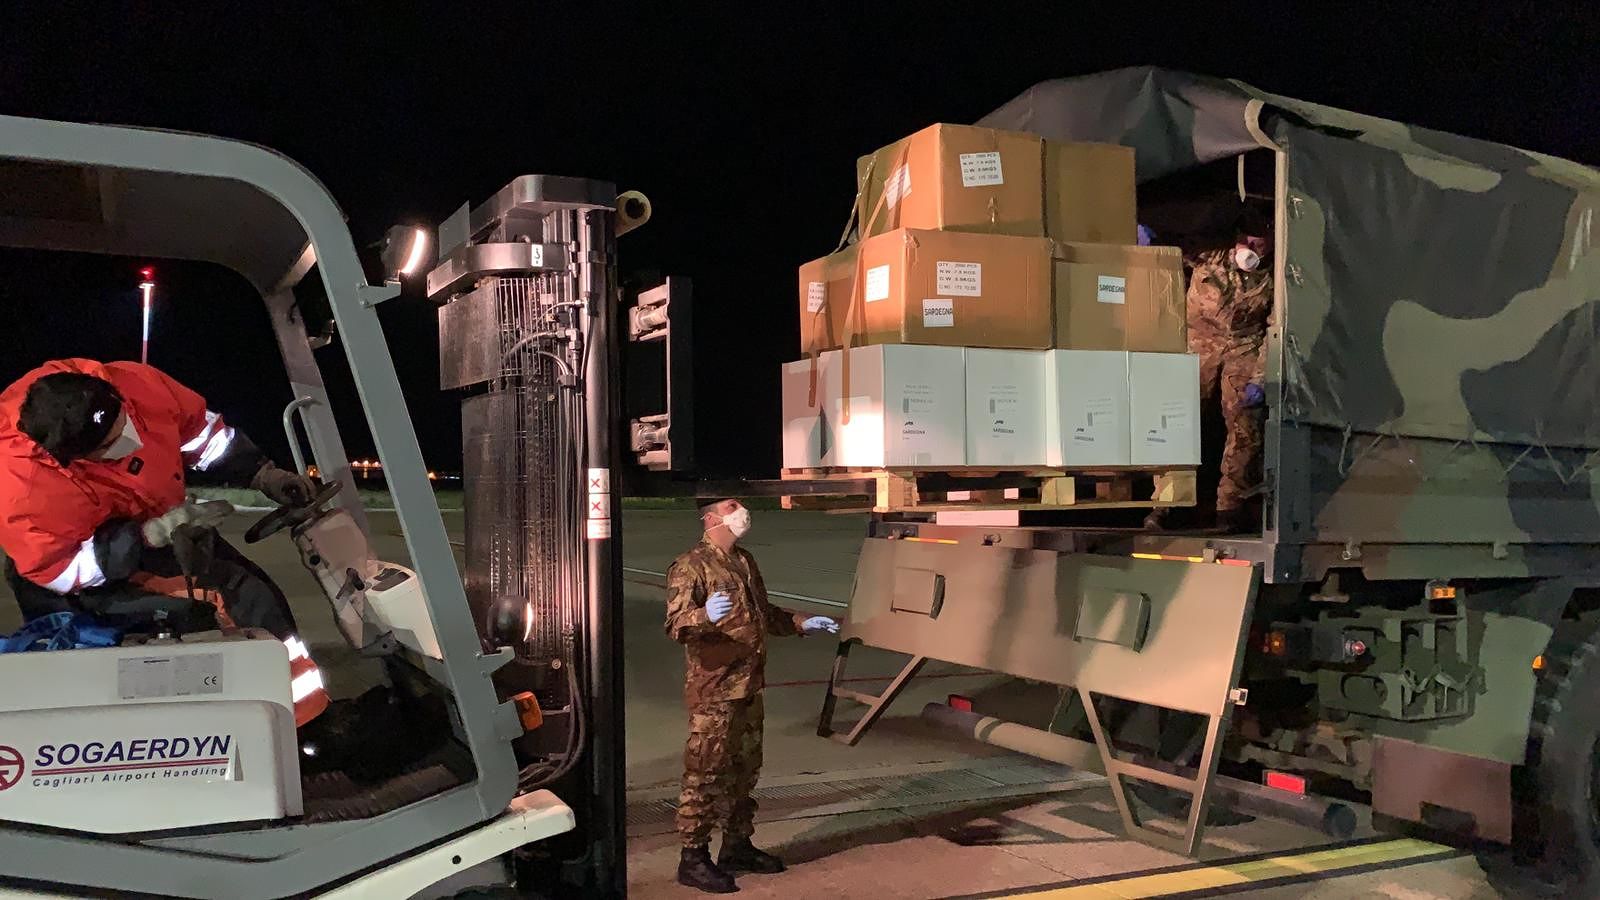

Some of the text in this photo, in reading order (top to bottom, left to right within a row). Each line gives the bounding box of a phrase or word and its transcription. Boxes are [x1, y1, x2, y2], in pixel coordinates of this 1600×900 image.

[1099, 284, 1125, 293] SARDEGNA
[925, 308, 953, 316] SARDEGNA
[34, 734, 231, 767] SOGAERDYN
[33, 766, 227, 788] Cagliari Airport Handling
